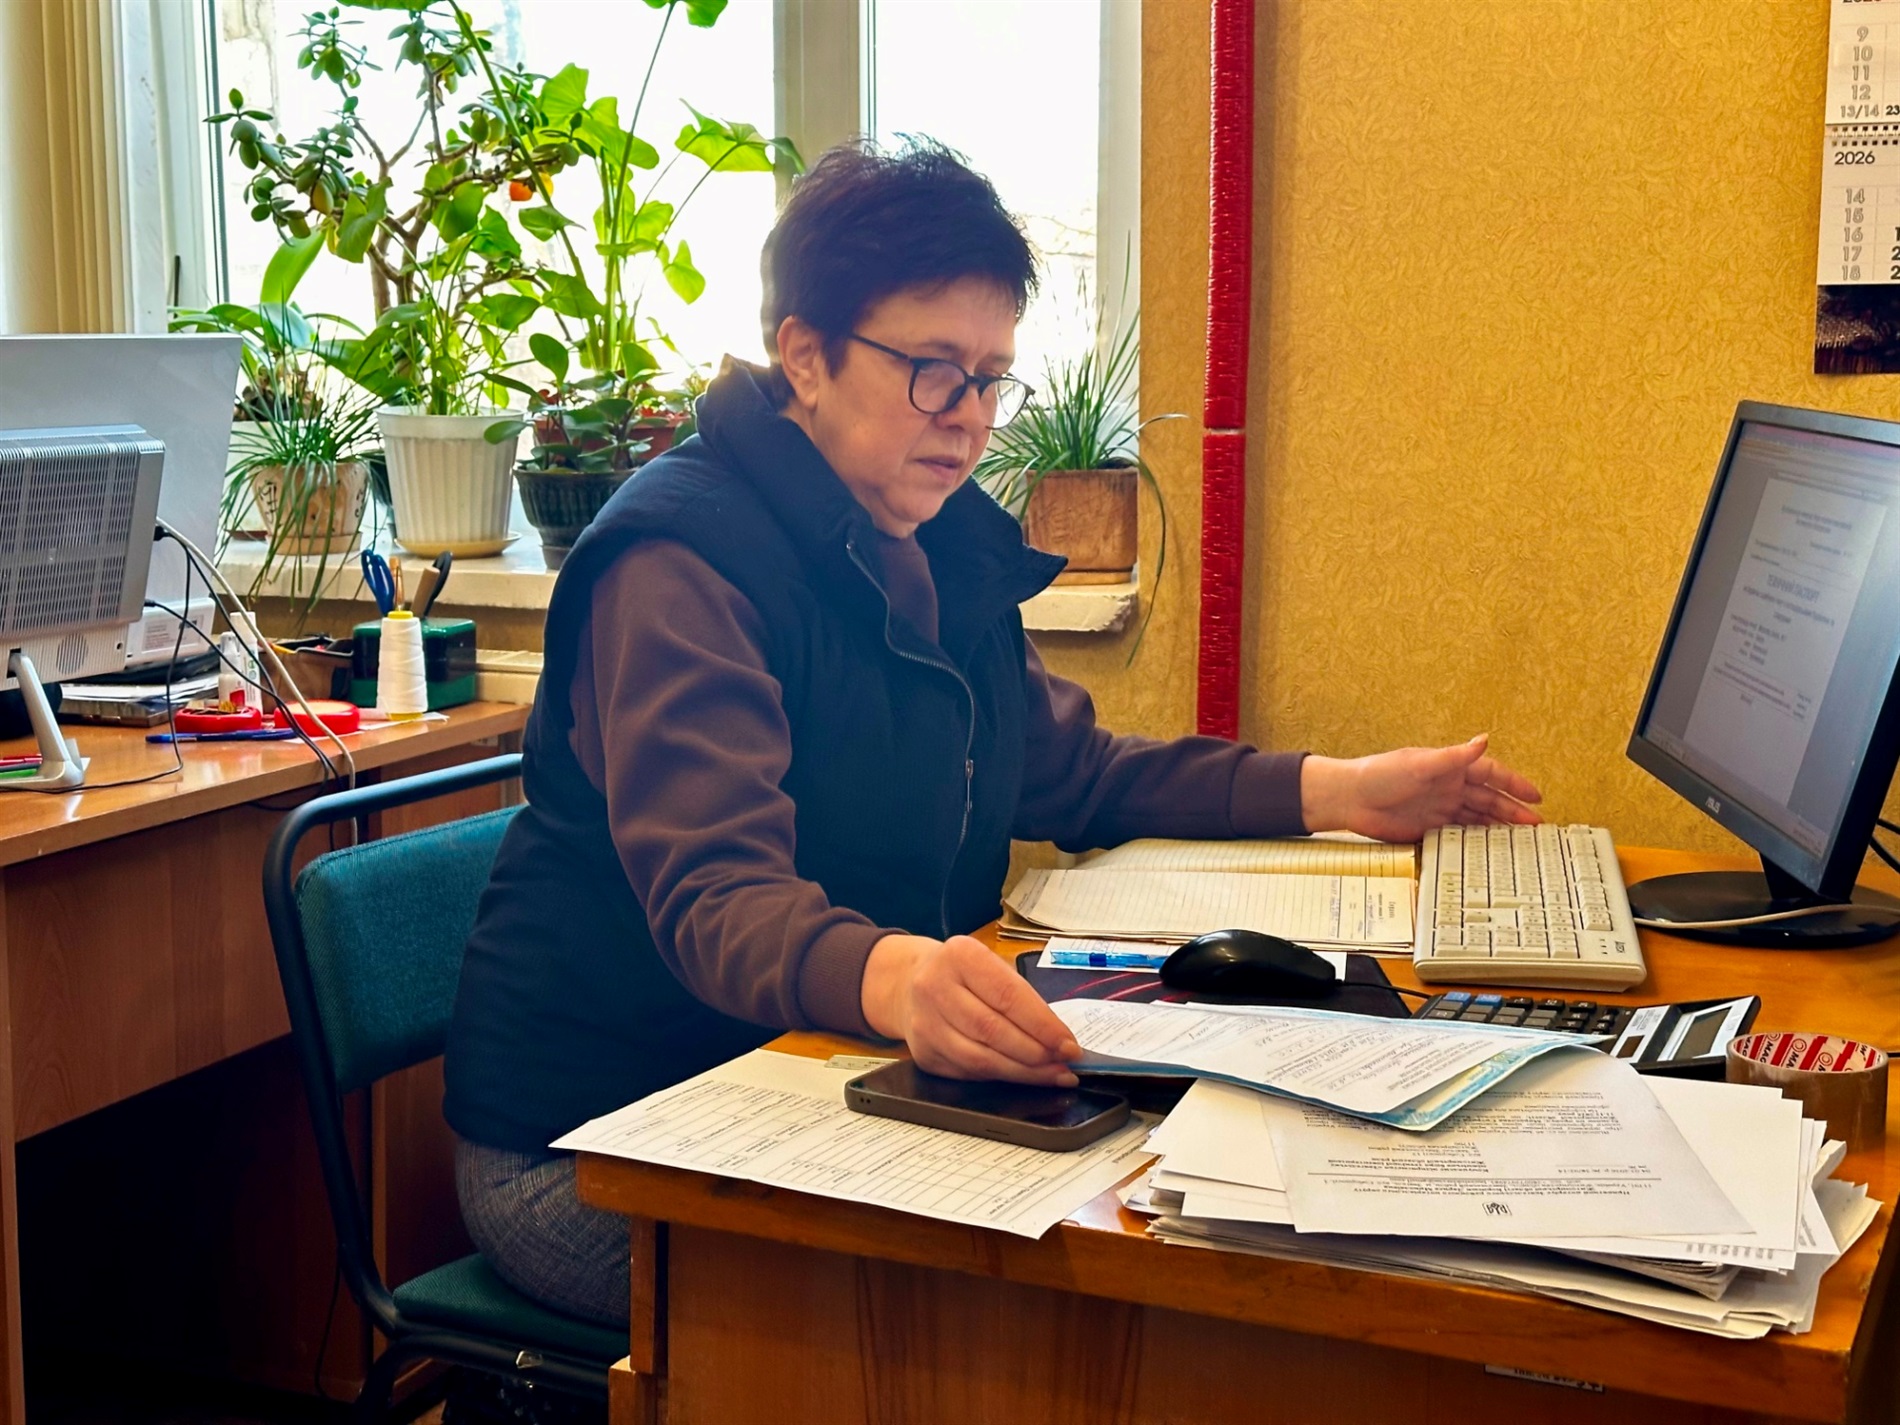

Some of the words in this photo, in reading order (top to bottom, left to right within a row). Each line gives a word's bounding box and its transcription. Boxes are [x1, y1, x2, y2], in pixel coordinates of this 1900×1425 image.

[1856, 26, 1869, 42] 9
[1853, 45, 1873, 62] 10
[1852, 64, 1870, 81] 11
[1851, 84, 1871, 101] 12
[1840, 104, 1880, 119] 13/14
[1834, 150, 1876, 165] 2026
[1845, 187, 1866, 205] 14
[1844, 207, 1864, 224] 15
[1843, 226, 1864, 243] 16
[1842, 245, 1862, 262] 17
[1841, 264, 1861, 281] 18
